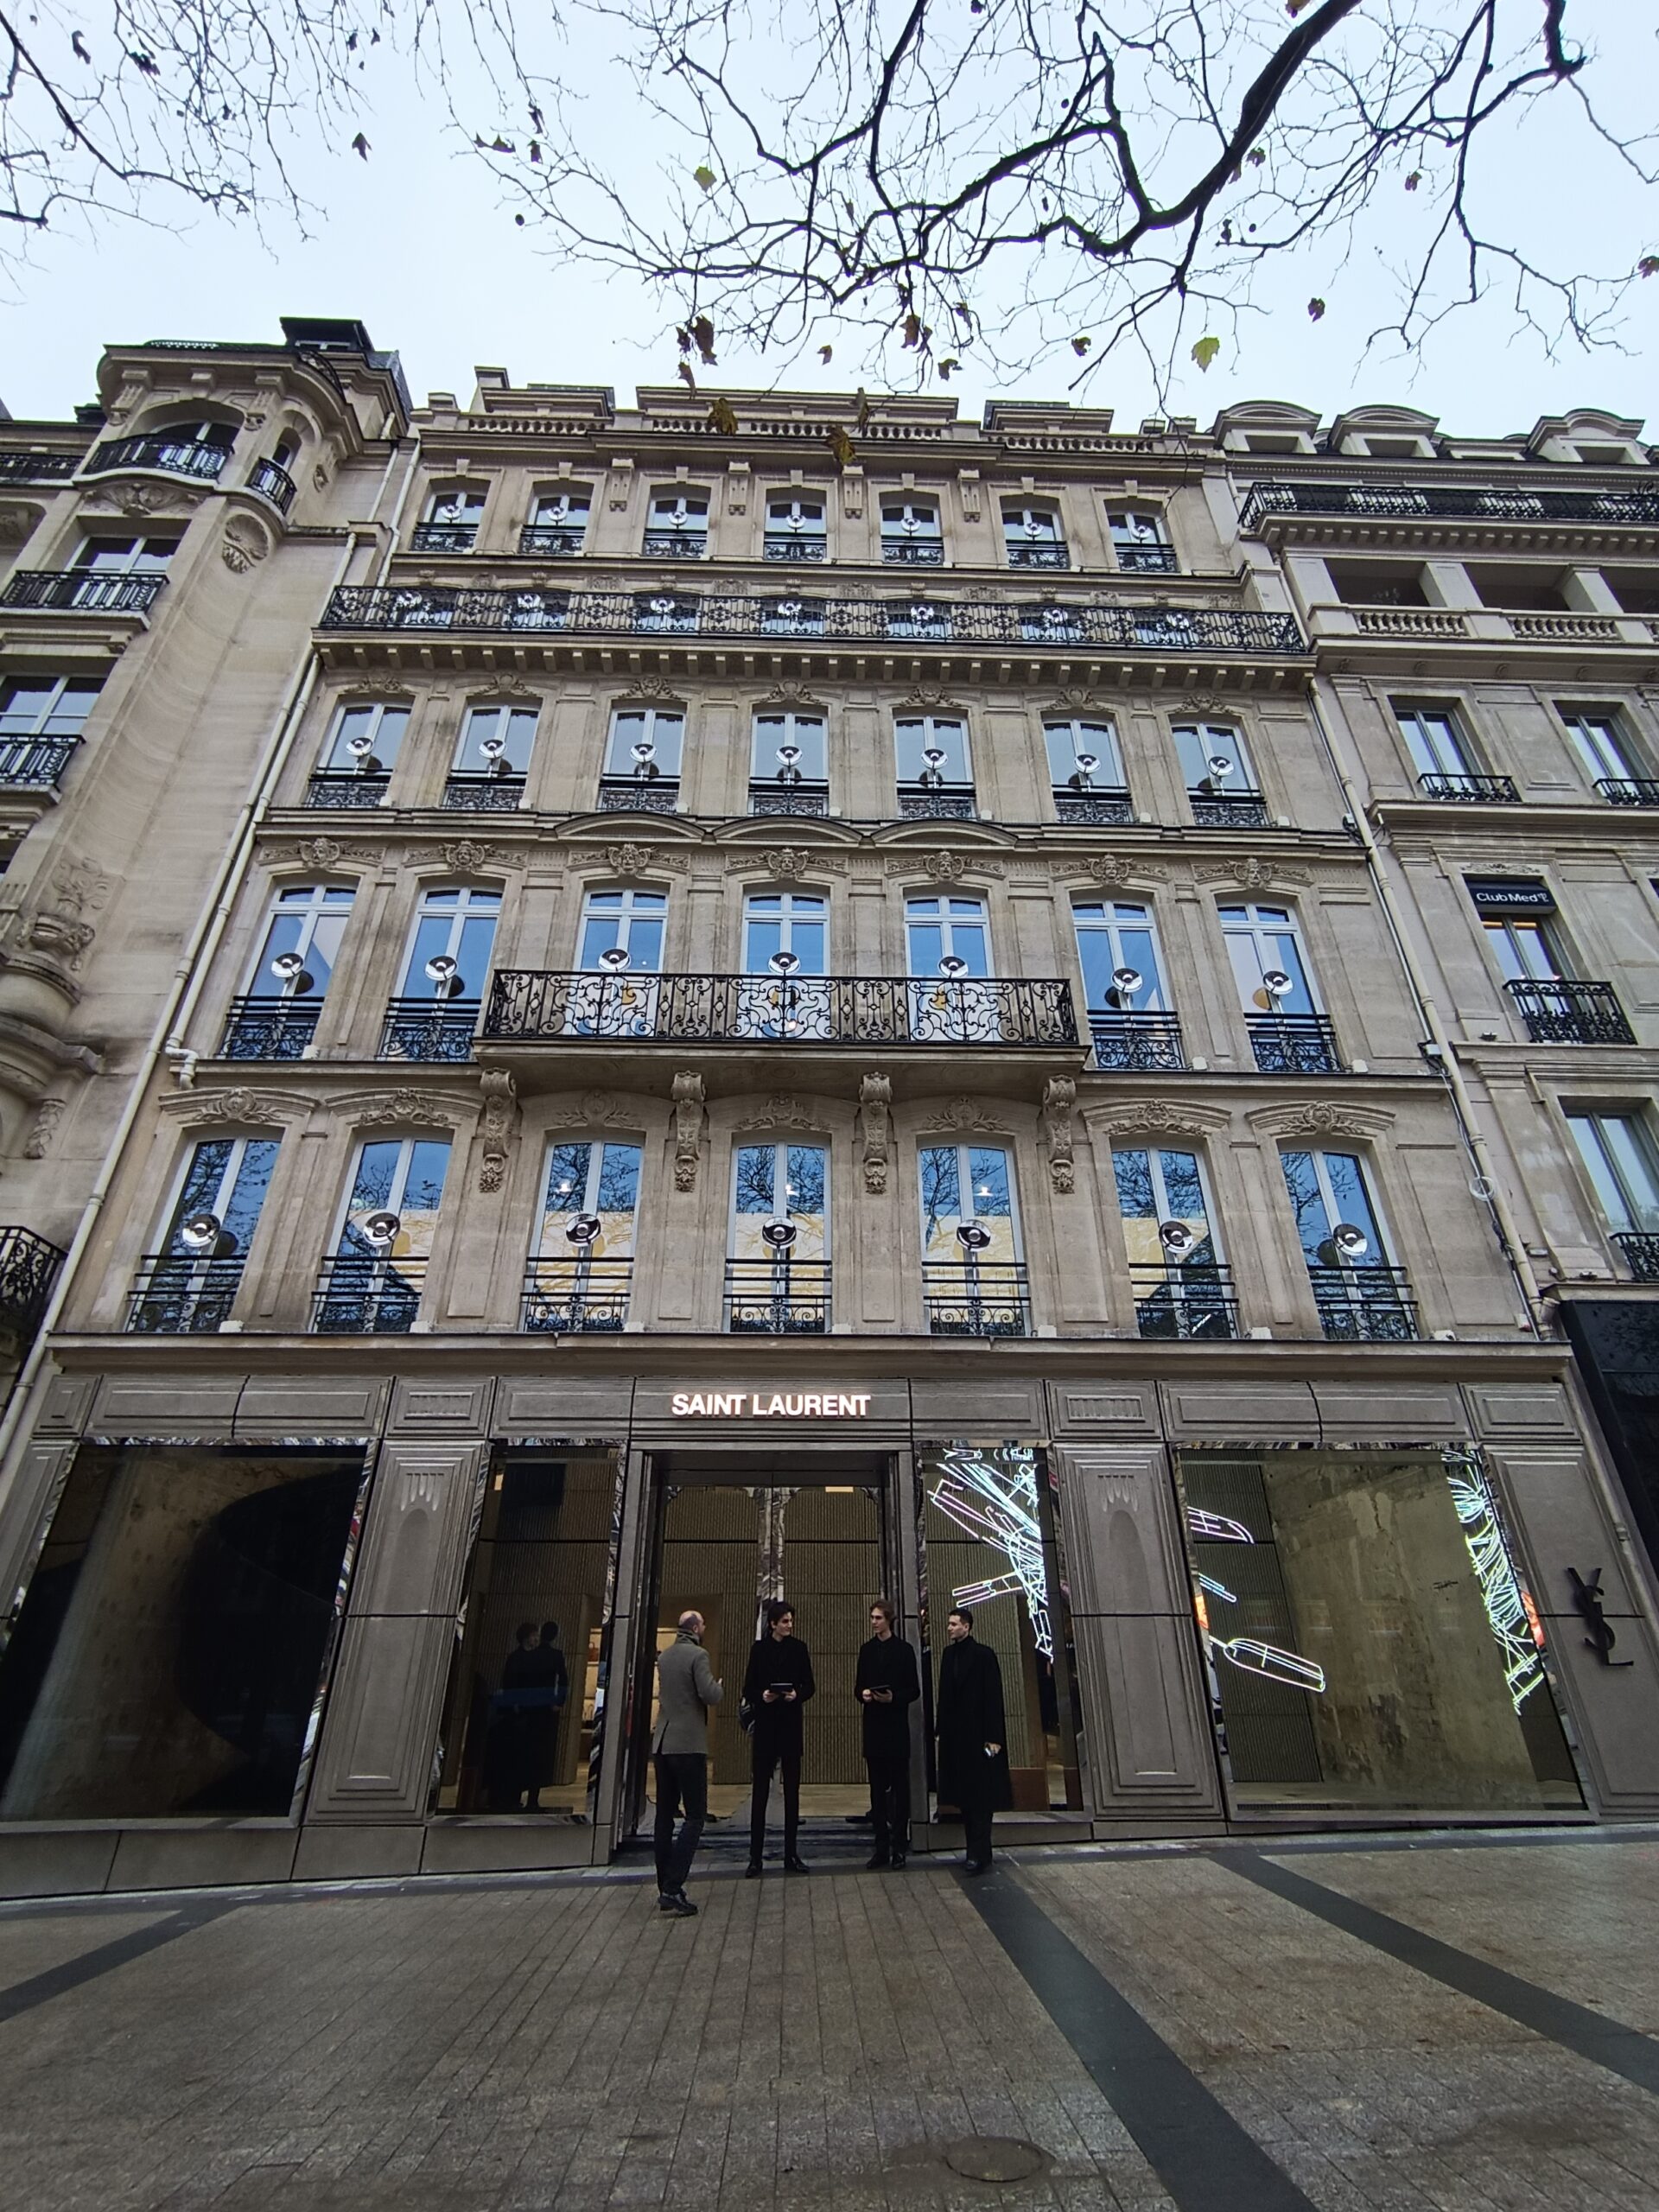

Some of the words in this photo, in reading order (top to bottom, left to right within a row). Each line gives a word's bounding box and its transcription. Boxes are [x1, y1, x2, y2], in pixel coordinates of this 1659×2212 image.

[1476, 893, 1507, 901] Club
[1509, 893, 1538, 902] Med
[671, 1394, 747, 1415] SAINT
[753, 1395, 871, 1416] LAURENT
